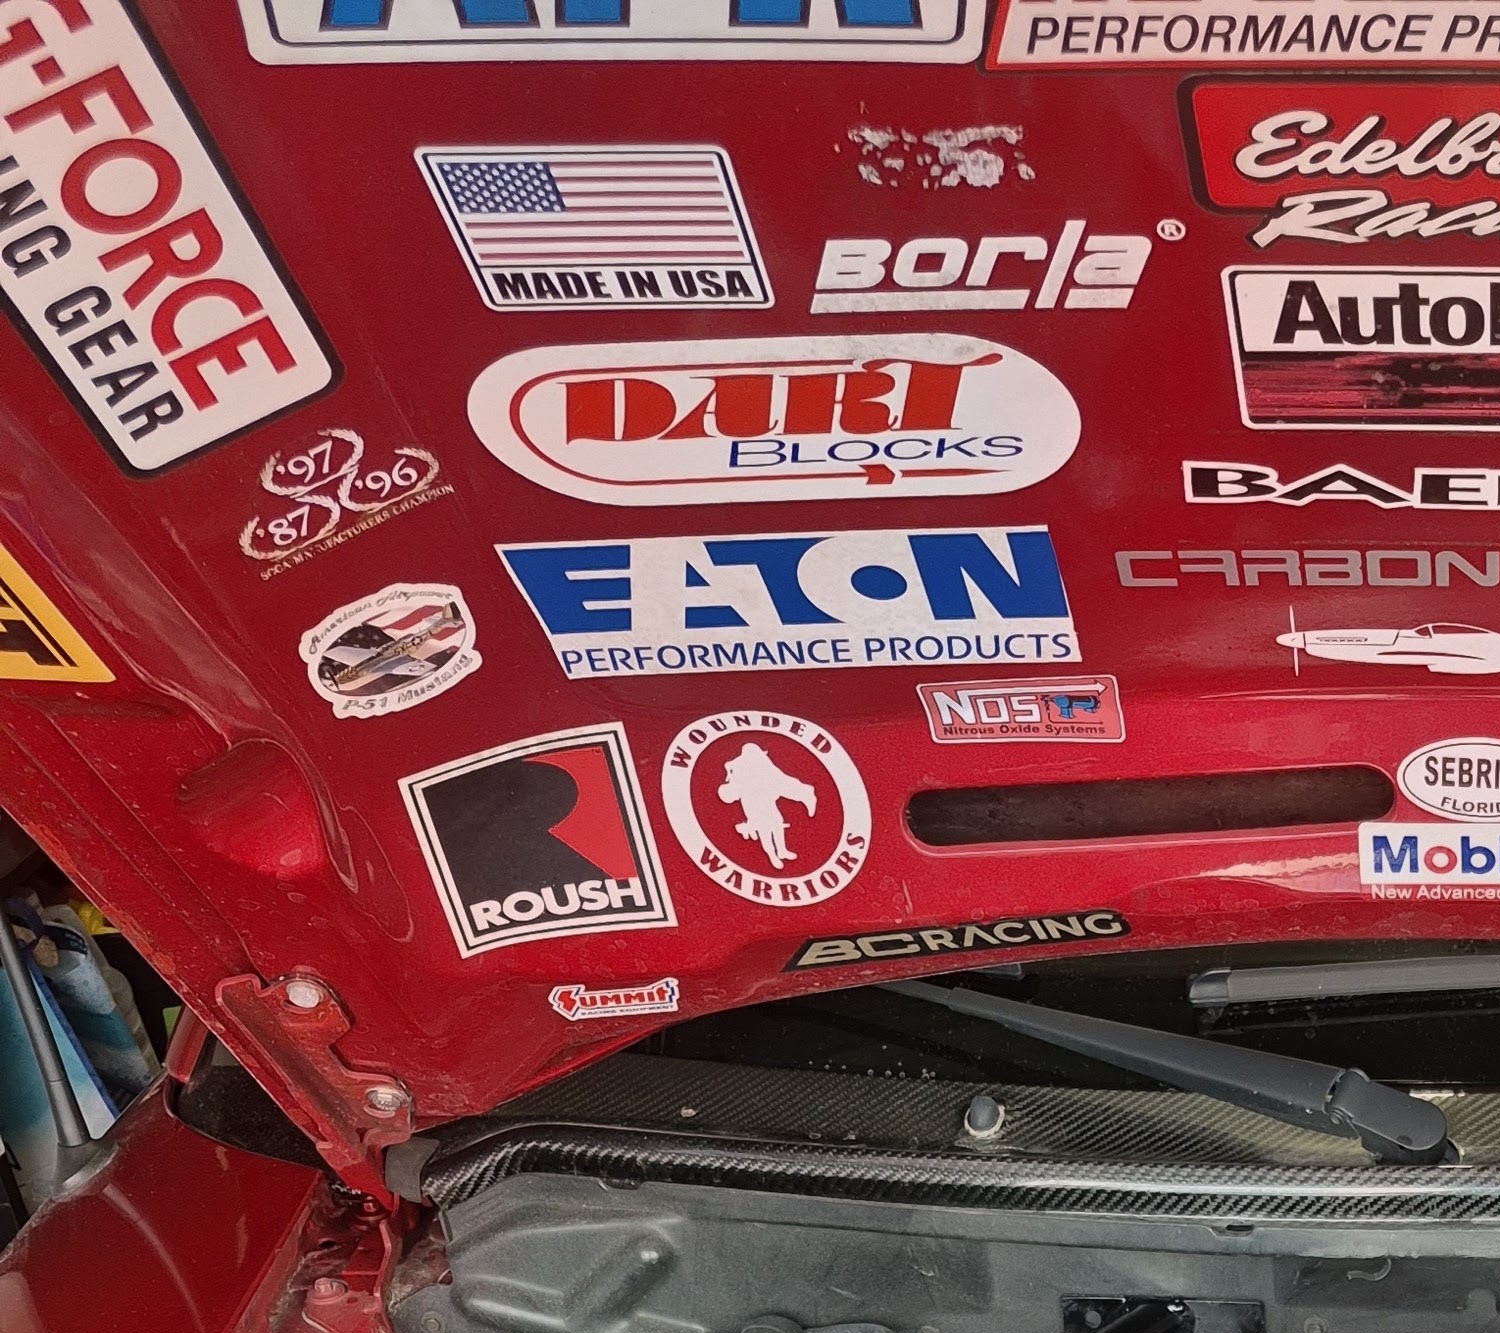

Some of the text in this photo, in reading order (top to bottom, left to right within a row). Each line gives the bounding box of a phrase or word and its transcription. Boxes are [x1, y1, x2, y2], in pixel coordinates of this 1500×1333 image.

[1028, 14, 1433, 55] PERFORMANCE
[493, 270, 754, 300] MADE IN USA
[44, 284, 185, 442] GEAR
[558, 354, 1004, 442] DART
[277, 440, 333, 484] '97
[727, 435, 1024, 469] BLOCKS
[354, 457, 418, 498] '96
[256, 505, 311, 546] '87
[293, 510, 391, 567] MANUFACTURERS
[392, 484, 455, 516] CHAMPION
[503, 530, 1071, 635] EATON
[1115, 548, 1500, 588] CARBON
[561, 633, 1072, 675] PERFORMANCE PRODUCTS
[932, 690, 1042, 725] NOS
[669, 714, 833, 770] WOUNDED
[943, 724, 1106, 736] Nitrous Oxide Systems
[699, 831, 868, 903] WARRIORS
[468, 877, 648, 931] ROUSH
[1371, 884, 1413, 900] New
[796, 911, 1125, 968] BC RACING
